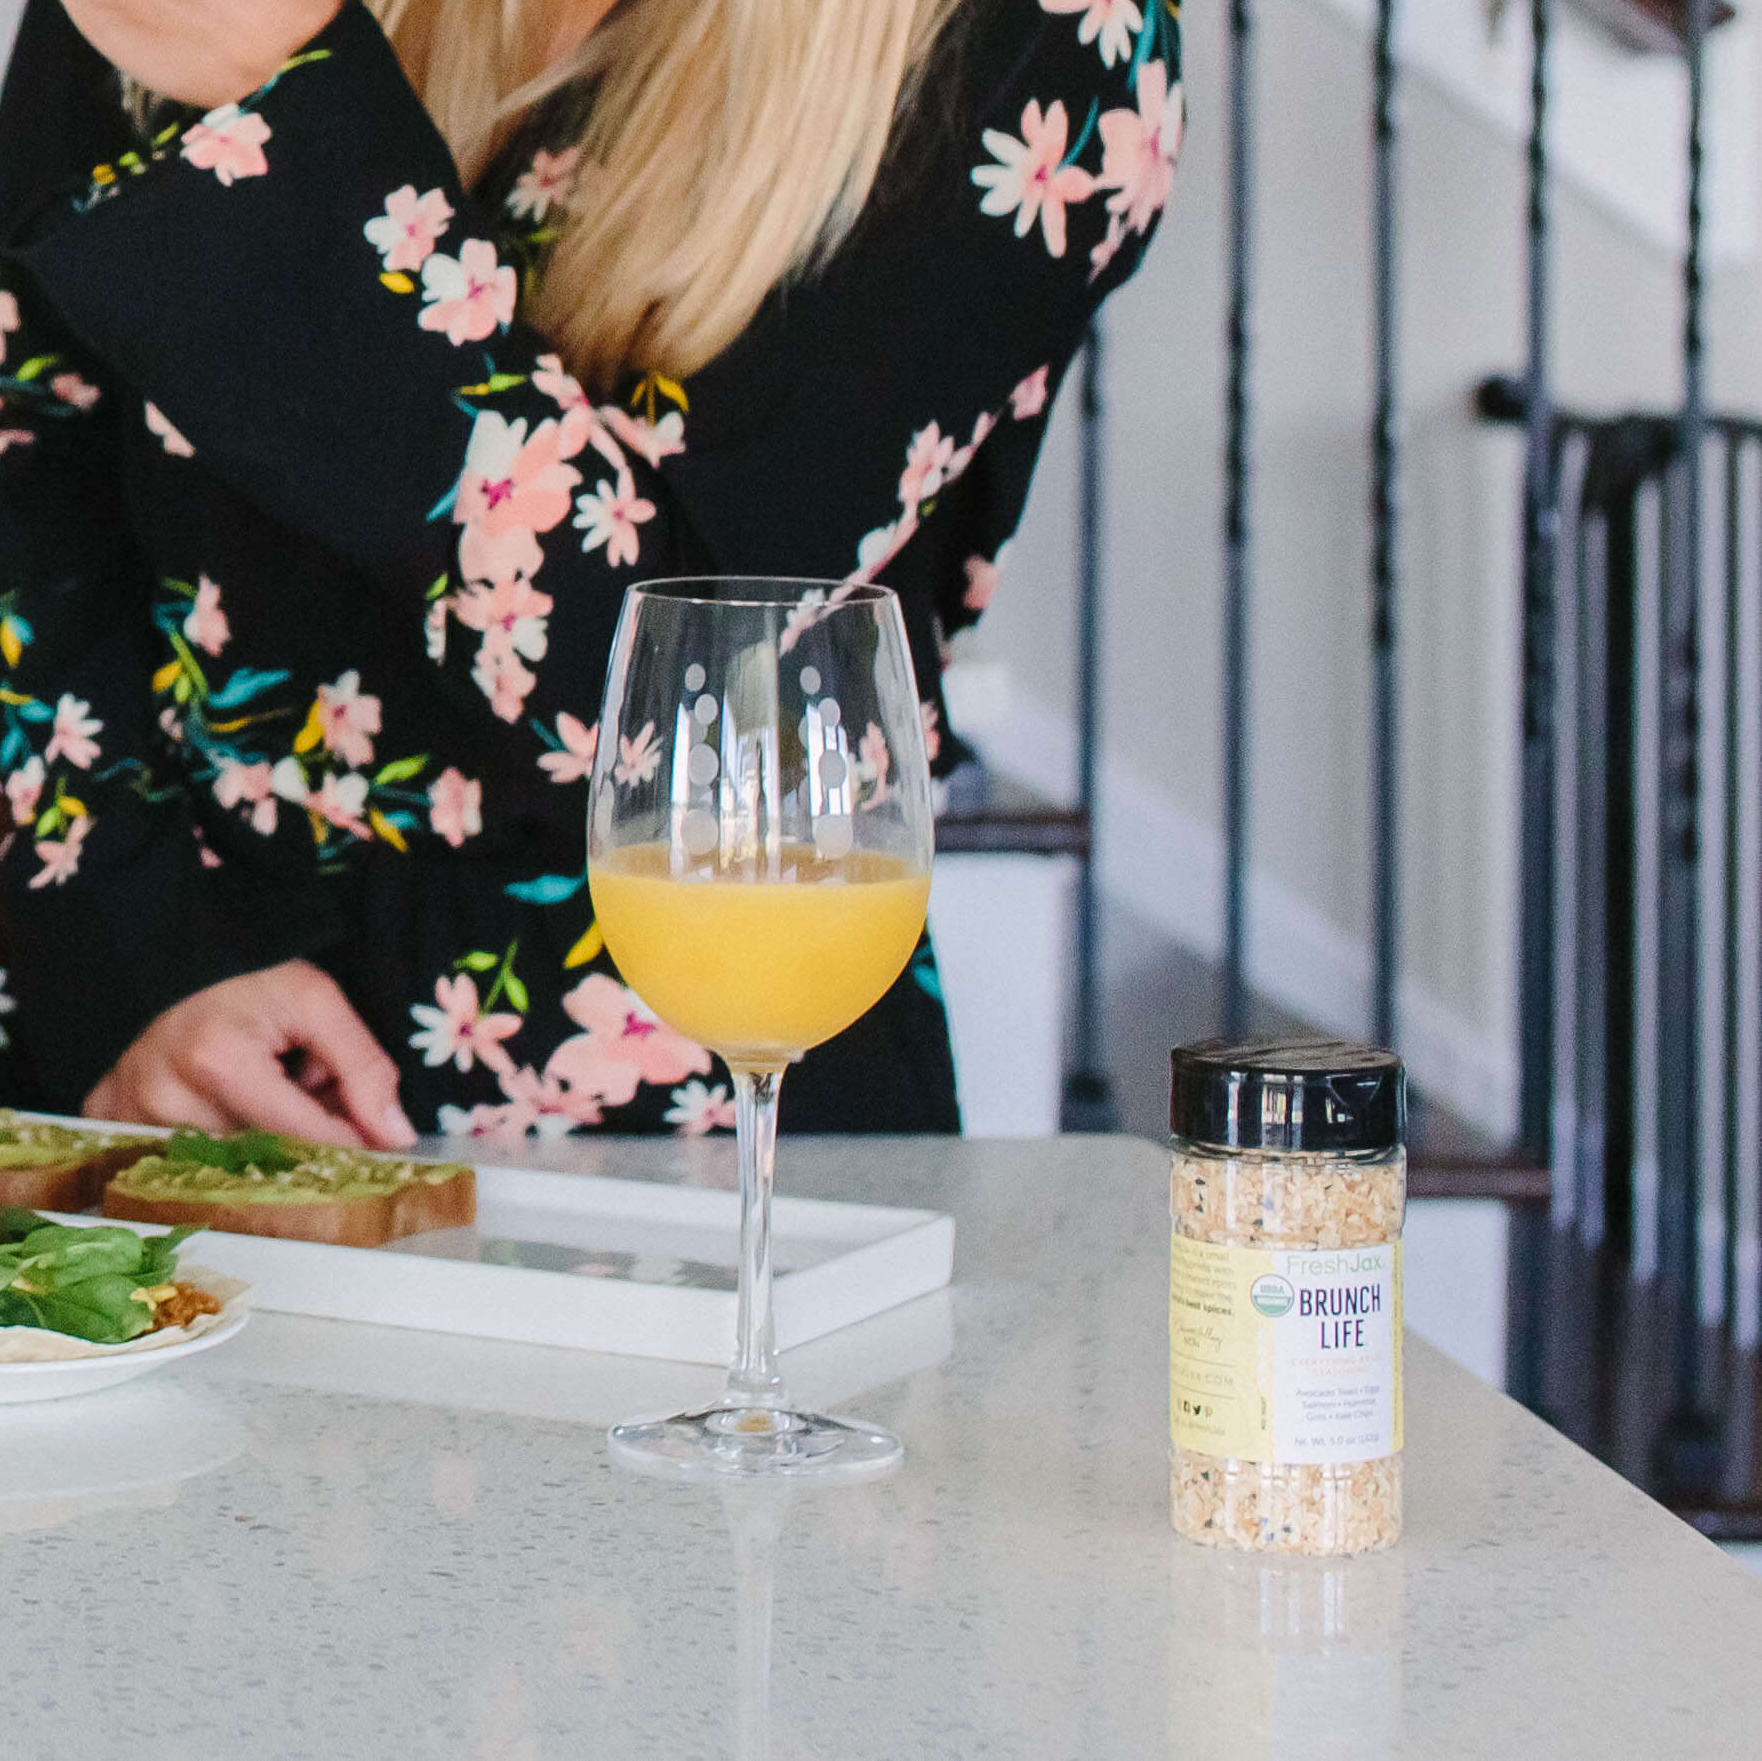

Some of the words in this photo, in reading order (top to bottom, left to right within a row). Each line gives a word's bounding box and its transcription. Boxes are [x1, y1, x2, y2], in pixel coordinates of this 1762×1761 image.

[1286, 1254, 1382, 1276] FreshJax
[1299, 1284, 1381, 1317] BRUNCH
[1320, 1319, 1365, 1349] LIFE
